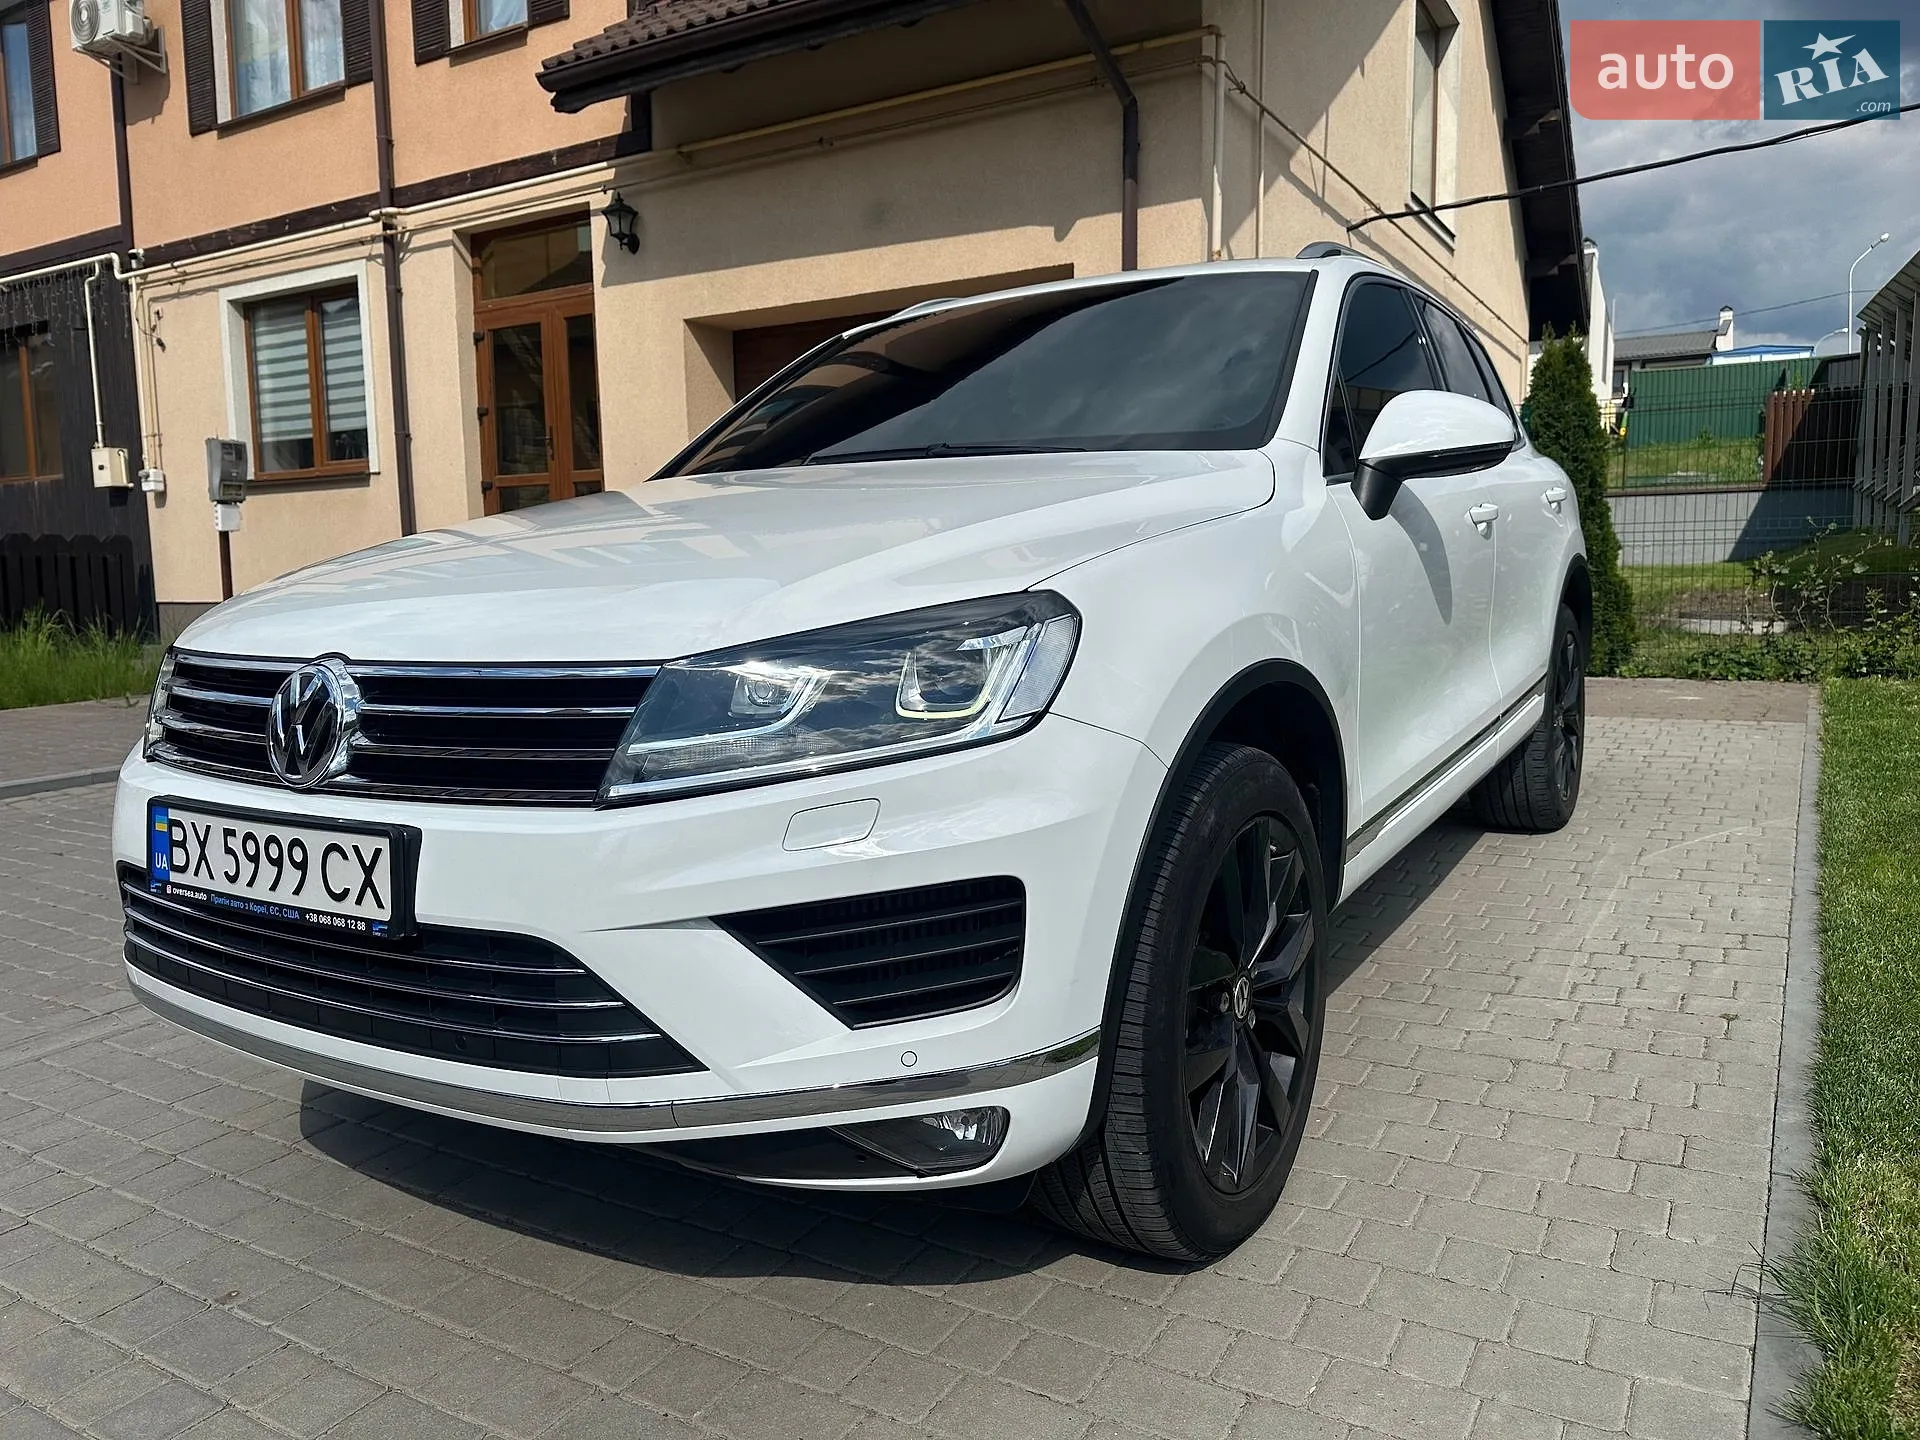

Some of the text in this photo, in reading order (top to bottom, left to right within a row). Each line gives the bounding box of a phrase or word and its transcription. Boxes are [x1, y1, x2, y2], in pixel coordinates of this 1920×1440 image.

[155, 852, 169, 871] UA
[168, 818, 386, 910] BX 5999 CX
[172, 887, 207, 901] oversea.auto
[230, 900, 244, 909] авто
[282, 908, 300, 920] США
[305, 912, 318, 922] +38
[319, 914, 332, 925] 068
[347, 919, 356, 930] 12
